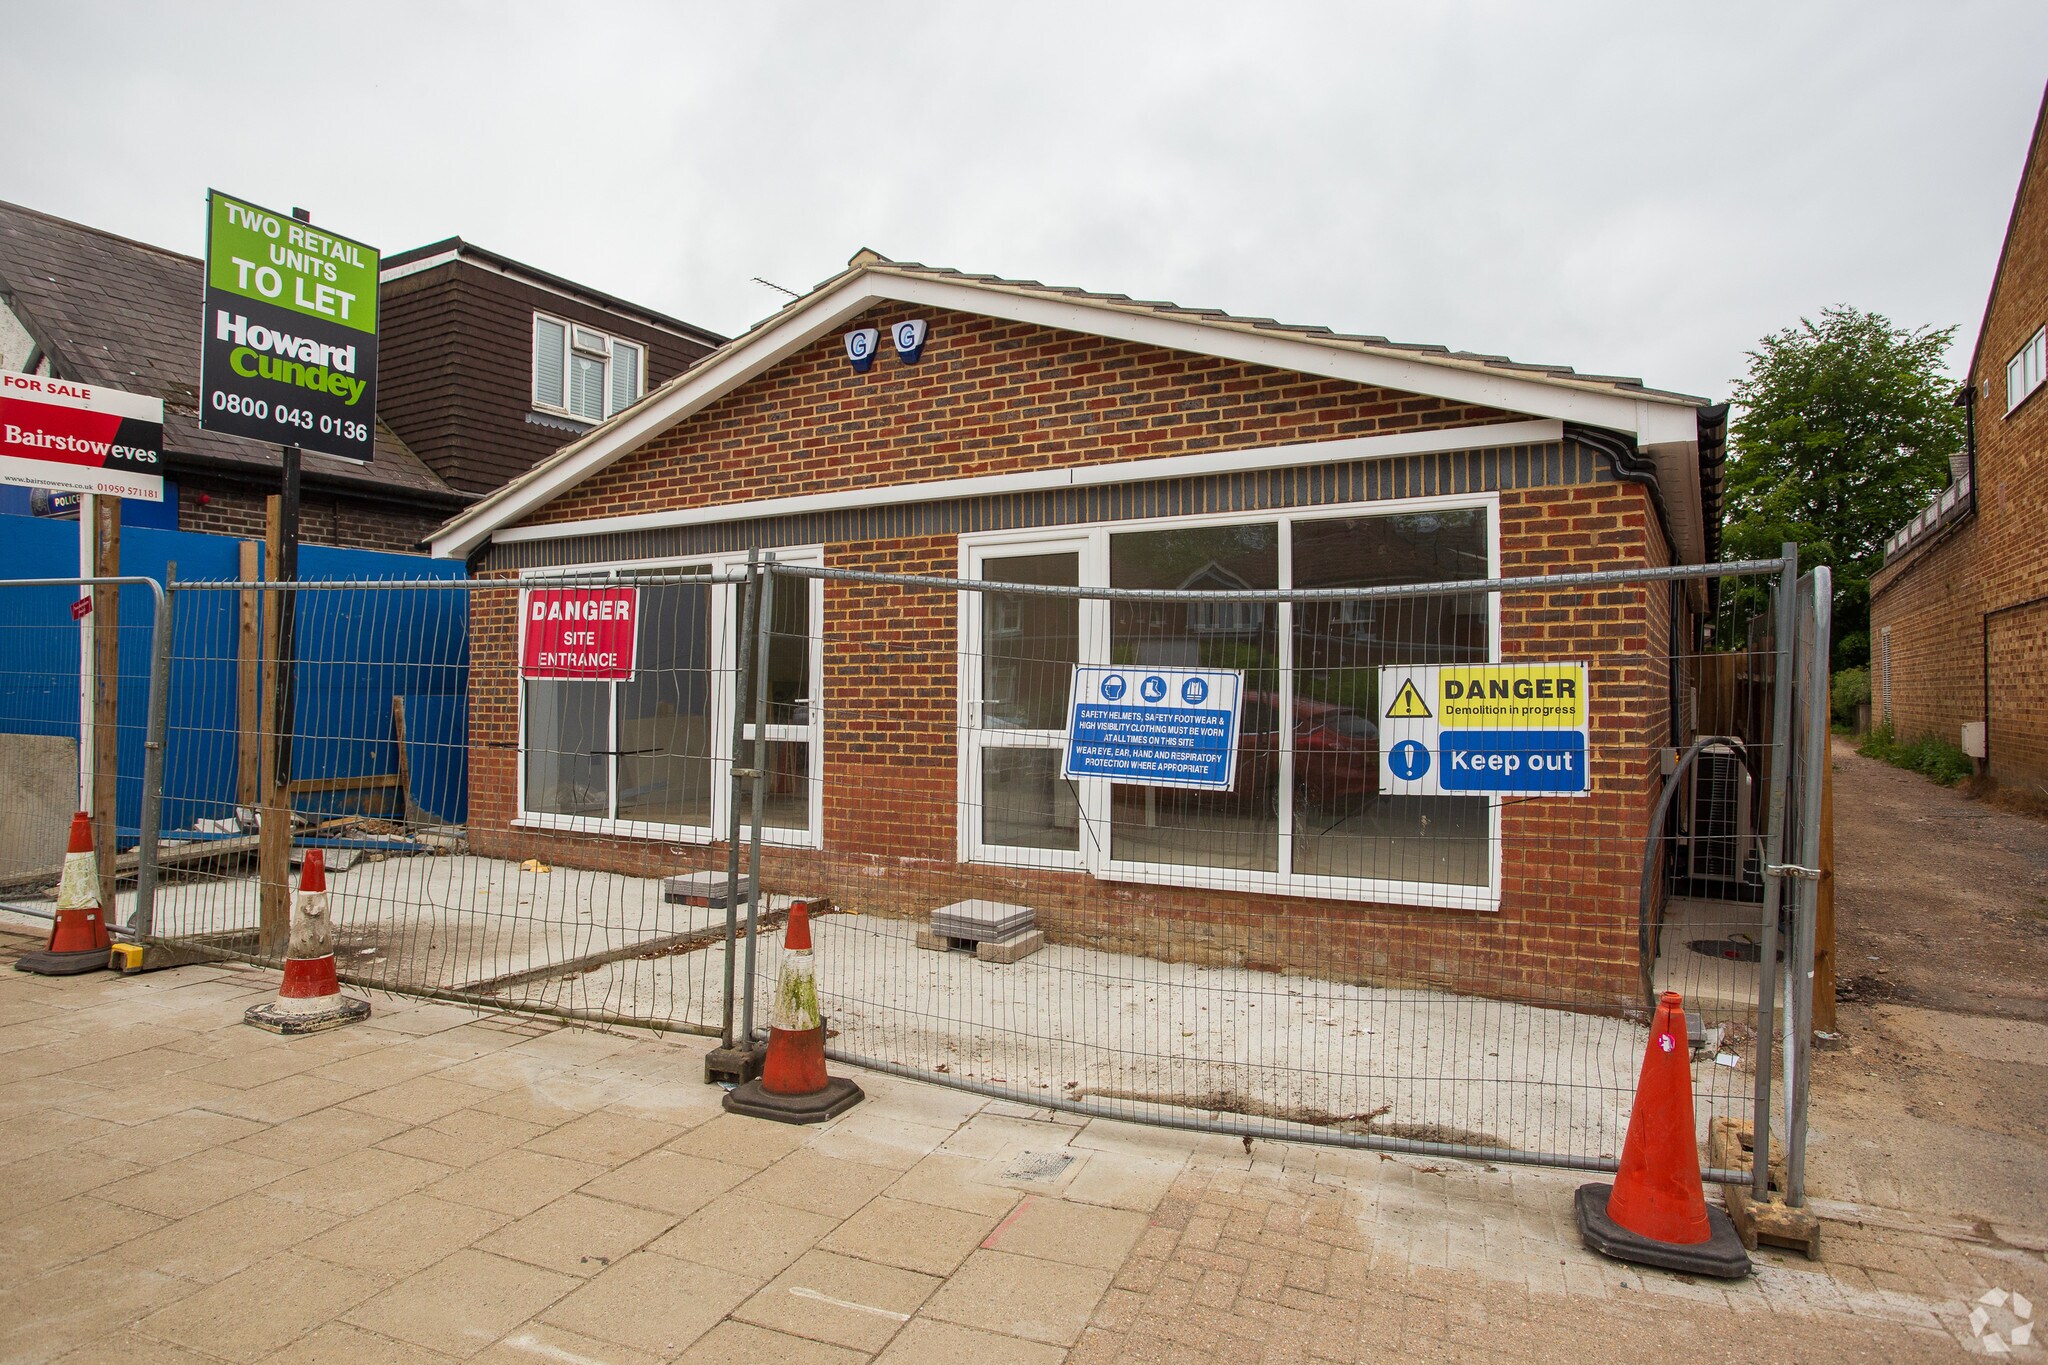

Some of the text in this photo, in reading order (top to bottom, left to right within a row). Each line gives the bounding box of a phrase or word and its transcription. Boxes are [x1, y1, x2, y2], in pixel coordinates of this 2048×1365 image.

[225, 202, 365, 269] TWO RETAIL
[270, 243, 337, 282] UNITS
[232, 257, 355, 320] TO LET
[216, 310, 355, 373] Howard
[229, 346, 366, 406] Cundey
[4, 376, 90, 400] FOR SALE
[213, 390, 367, 442] 0800 043 0136
[5, 475, 158, 499] www.bairstoweves.co.uk 01959 571181
[532, 601, 629, 621] DANGER
[564, 631, 594, 645] SITE
[539, 652, 617, 667] ENTRANCE
[1444, 679, 1576, 699] DANGER
[1081, 710, 1224, 725] SAFETY HELMETS, SAFETY FOOTWEAR &
[1446, 705, 1575, 717] Demolition in progress
[1097, 723, 1130, 731] VISIBILITY
[1131, 724, 1166, 733] CLOTHING
[1168, 726, 1188, 735] MUST
[1201, 728, 1224, 736] WORN
[1104, 734, 1194, 746] AT ALL TIMES ON THIS SITE
[1076, 746, 1222, 763] WEAR EYE, EAR, HAND AND RESPIRATORY
[1451, 750, 1572, 775] Keep out
[1085, 758, 1209, 774] PROTECTION WHERE APPROPRIATE
